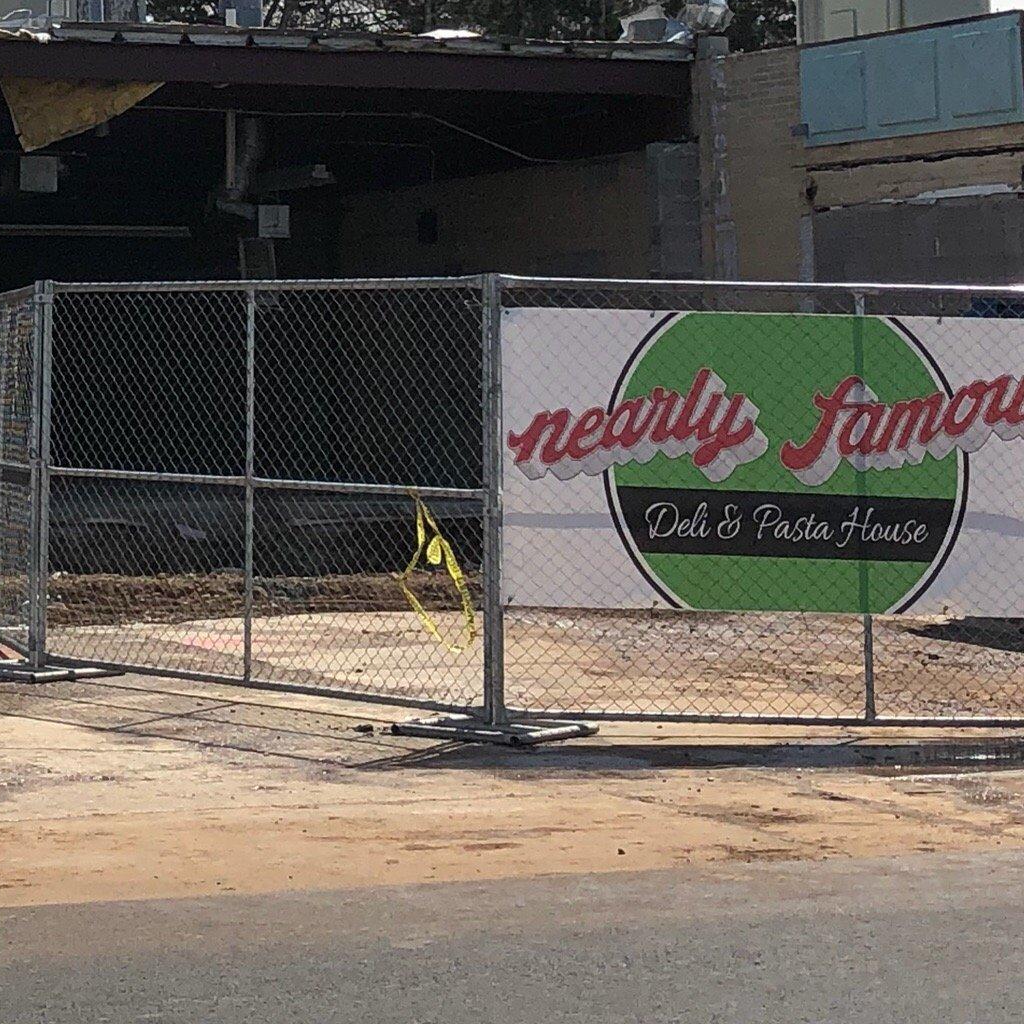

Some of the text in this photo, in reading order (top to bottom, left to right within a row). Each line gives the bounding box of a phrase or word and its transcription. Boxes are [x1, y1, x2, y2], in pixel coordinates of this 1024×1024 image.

[508, 367, 764, 479] nearly
[645, 502, 929, 548] Deli & Pasta House
